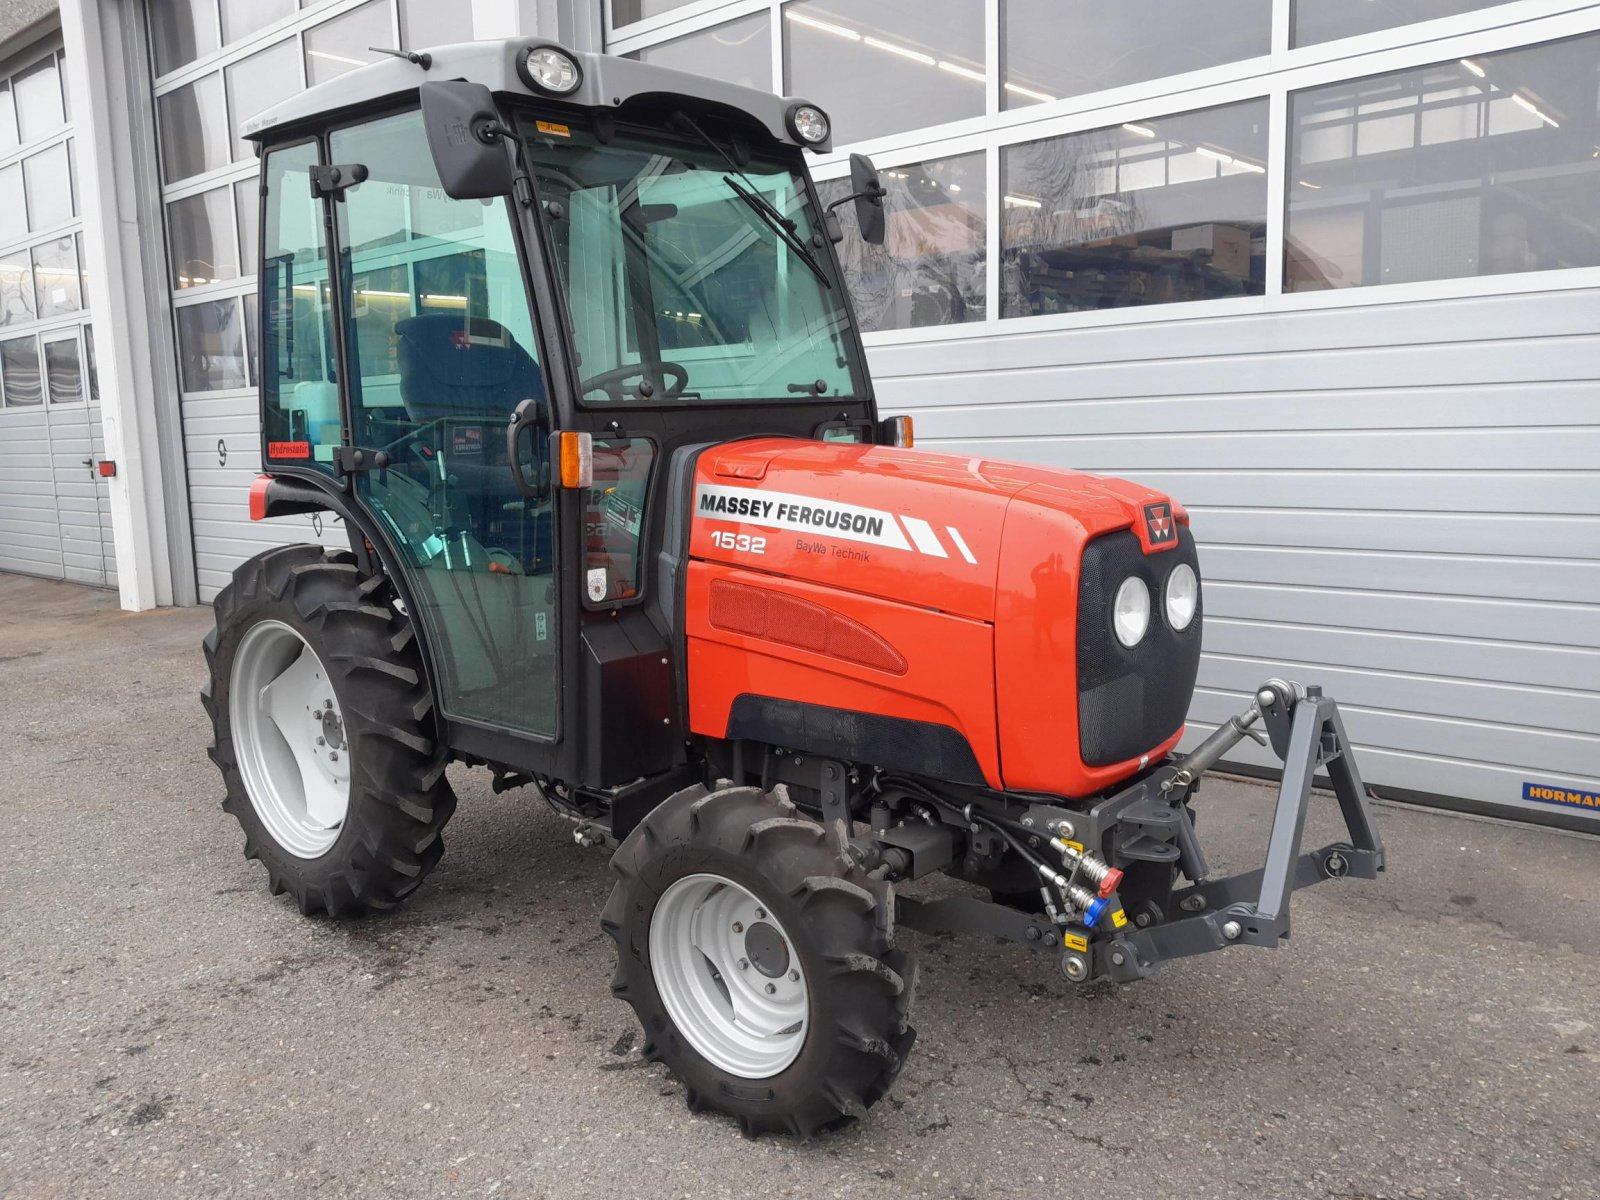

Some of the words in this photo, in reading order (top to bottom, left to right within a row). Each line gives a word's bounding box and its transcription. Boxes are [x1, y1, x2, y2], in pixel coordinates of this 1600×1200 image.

[218, 438, 227, 467] 9
[700, 493, 773, 518] MASSEY
[776, 503, 884, 537] FERGUSON
[710, 530, 767, 554] 1532
[796, 539, 827, 556] BayWa
[830, 545, 872, 563] Technik
